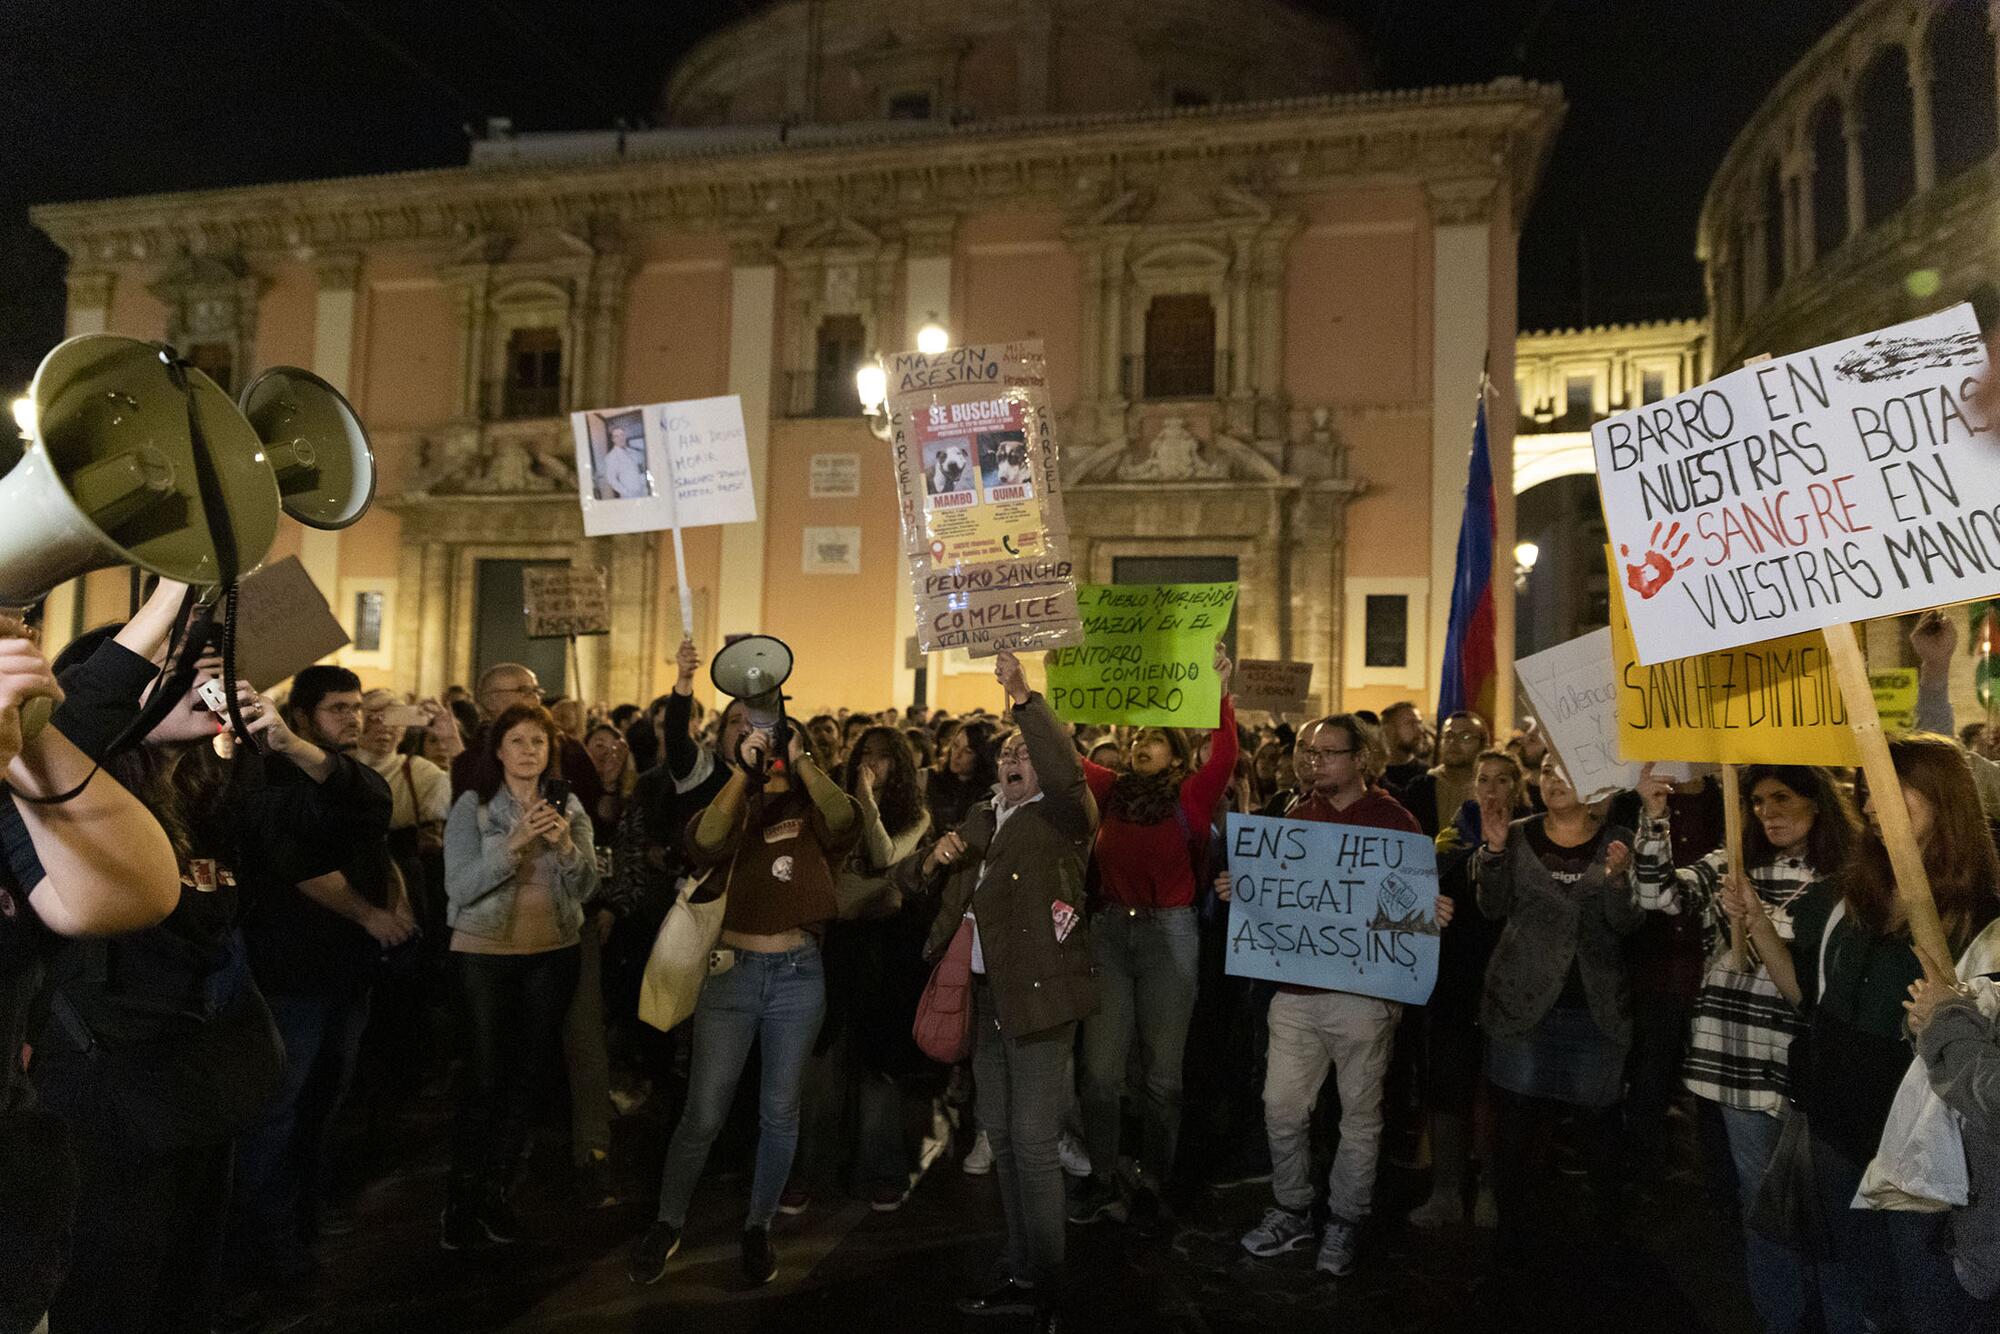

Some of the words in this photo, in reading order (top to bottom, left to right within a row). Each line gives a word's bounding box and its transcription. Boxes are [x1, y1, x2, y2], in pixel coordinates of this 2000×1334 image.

[901, 362, 999, 389] ASESINO
[929, 404, 948, 425] SE
[952, 399, 1010, 423] BUSCAN
[1607, 390, 1734, 471] BARRO
[1756, 356, 1830, 422] EN
[1037, 405, 1056, 493] CARCEL
[1638, 421, 1827, 520] NUESTRAS
[934, 492, 973, 509] MAMBO
[1697, 475, 1872, 567] SANGRE
[1881, 453, 1960, 522] EN
[926, 571, 992, 593] PEDRO
[1682, 541, 1882, 630] VUESTRAS
[1883, 504, 2000, 590] MANO
[934, 597, 1061, 632] COMPLICE
[1098, 589, 1148, 607] PUEBLO
[1153, 588, 1234, 608] MURIENDO
[1158, 615, 1183, 631] EN
[1188, 613, 1212, 630] EL
[1101, 662, 1199, 684] COMIENDO
[1624, 654, 1740, 729] SANCHEZ
[1745, 647, 1849, 729] DIMISIO
[1053, 686, 1183, 712] POTORRO
[1234, 825, 1308, 860] ENS
[1336, 833, 1404, 869] HEU
[1236, 874, 1365, 914] OFEGAT
[1232, 919, 1417, 967] ASSASSINS
